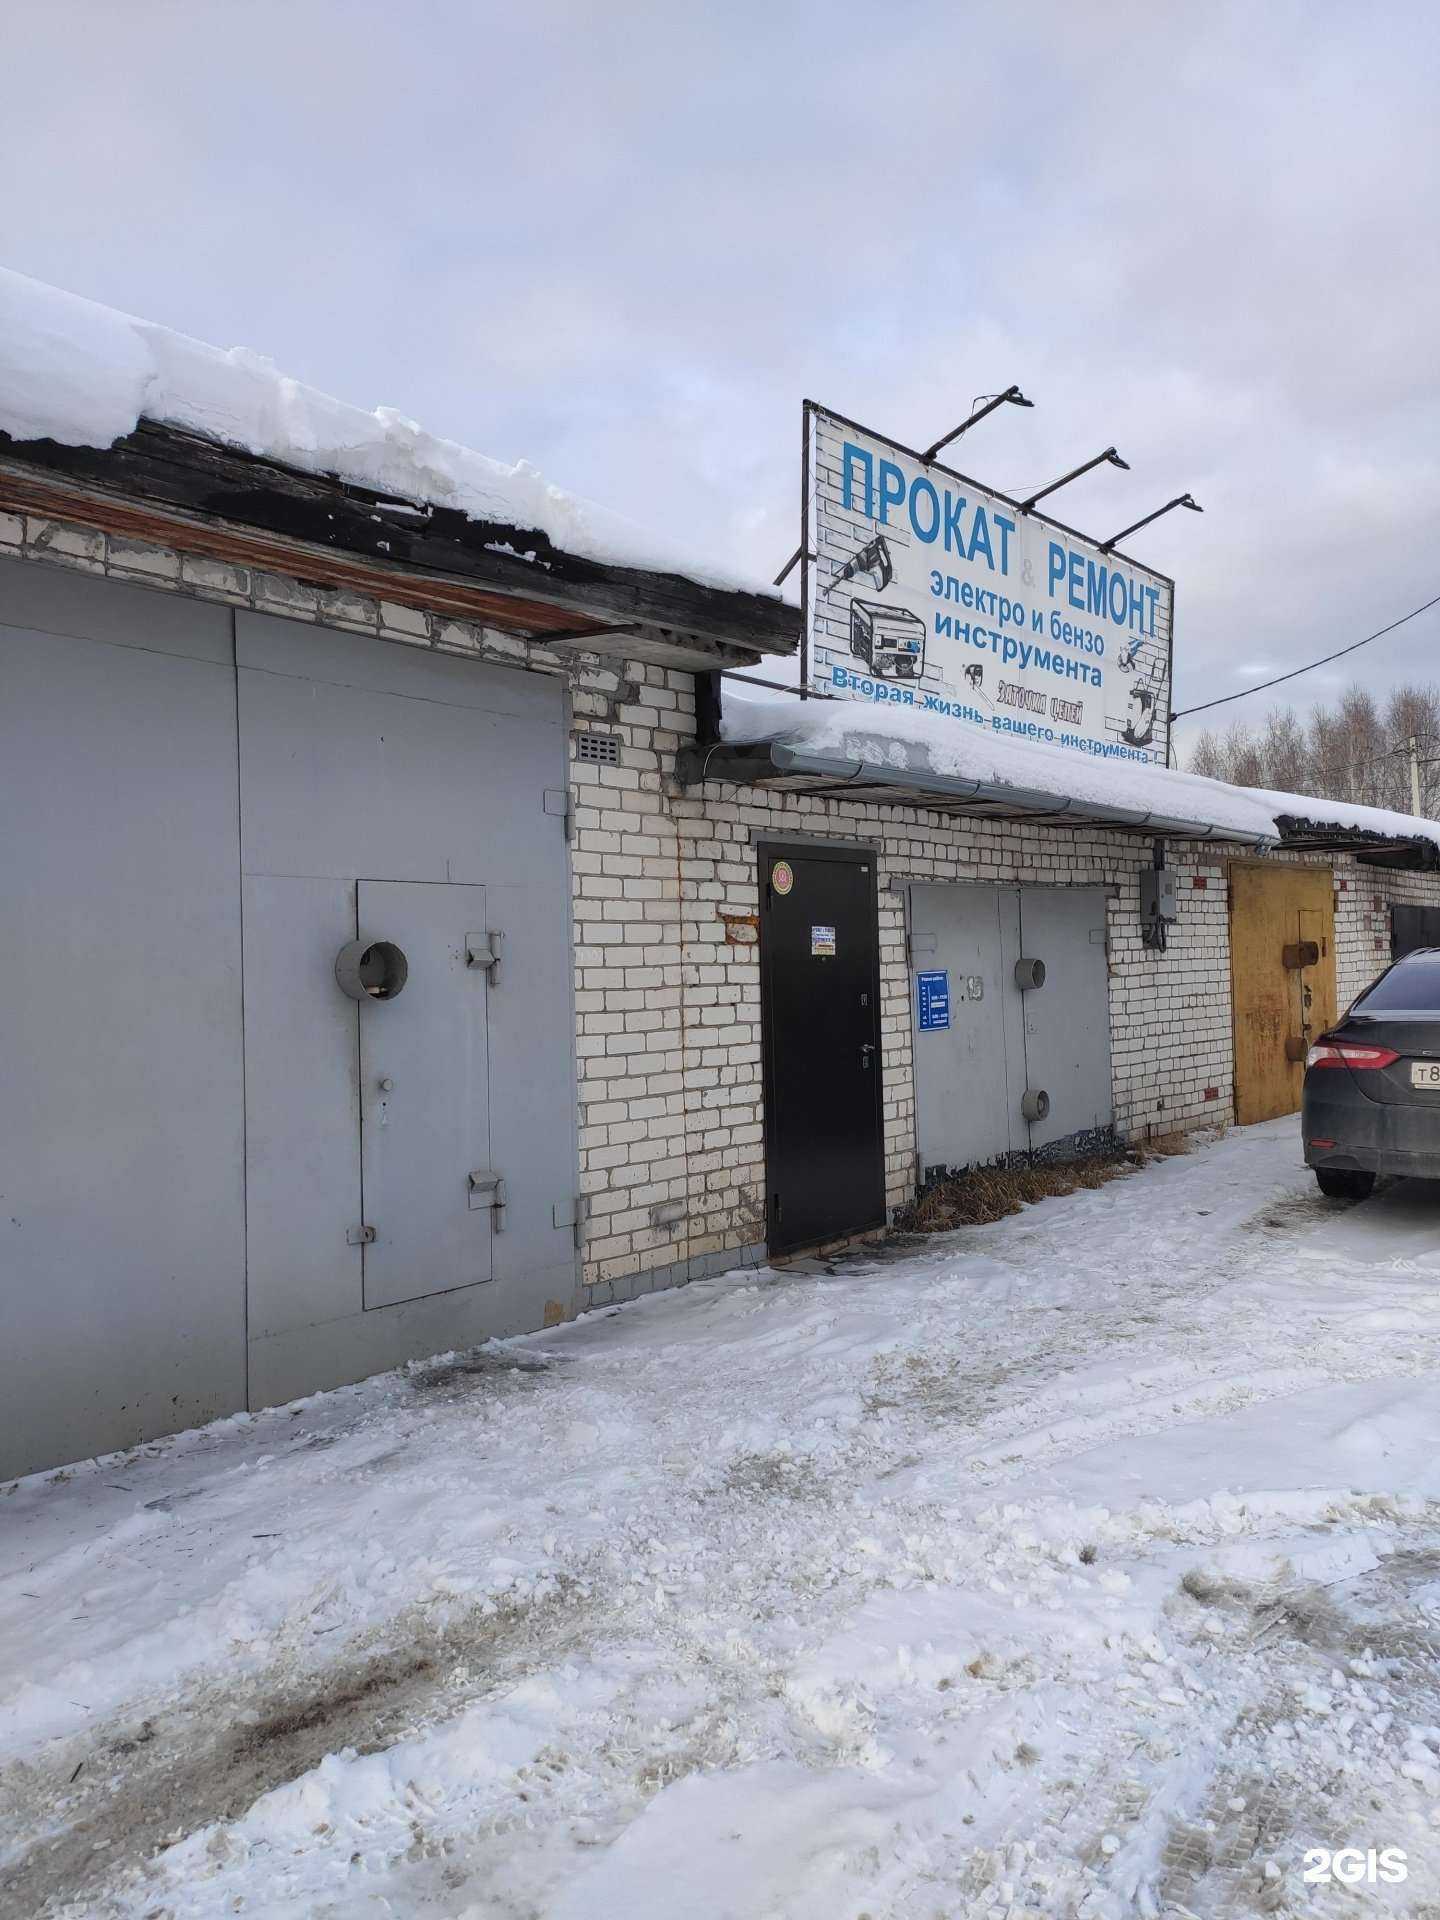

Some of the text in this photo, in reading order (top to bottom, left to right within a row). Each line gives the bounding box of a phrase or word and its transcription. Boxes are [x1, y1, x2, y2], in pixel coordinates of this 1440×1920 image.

[844, 441, 1016, 576] ПРОКАТ
[1048, 541, 1160, 638] РЕМОНТ
[930, 569, 1105, 656] электро и бензо
[935, 612, 1102, 688] инструмента
[832, 666, 914, 705] Вторая
[923, 694, 984, 724] жизнь
[992, 715, 1054, 742] вашего
[996, 679, 1084, 725] ЗАТОЧКА ЦЕПЕЙ
